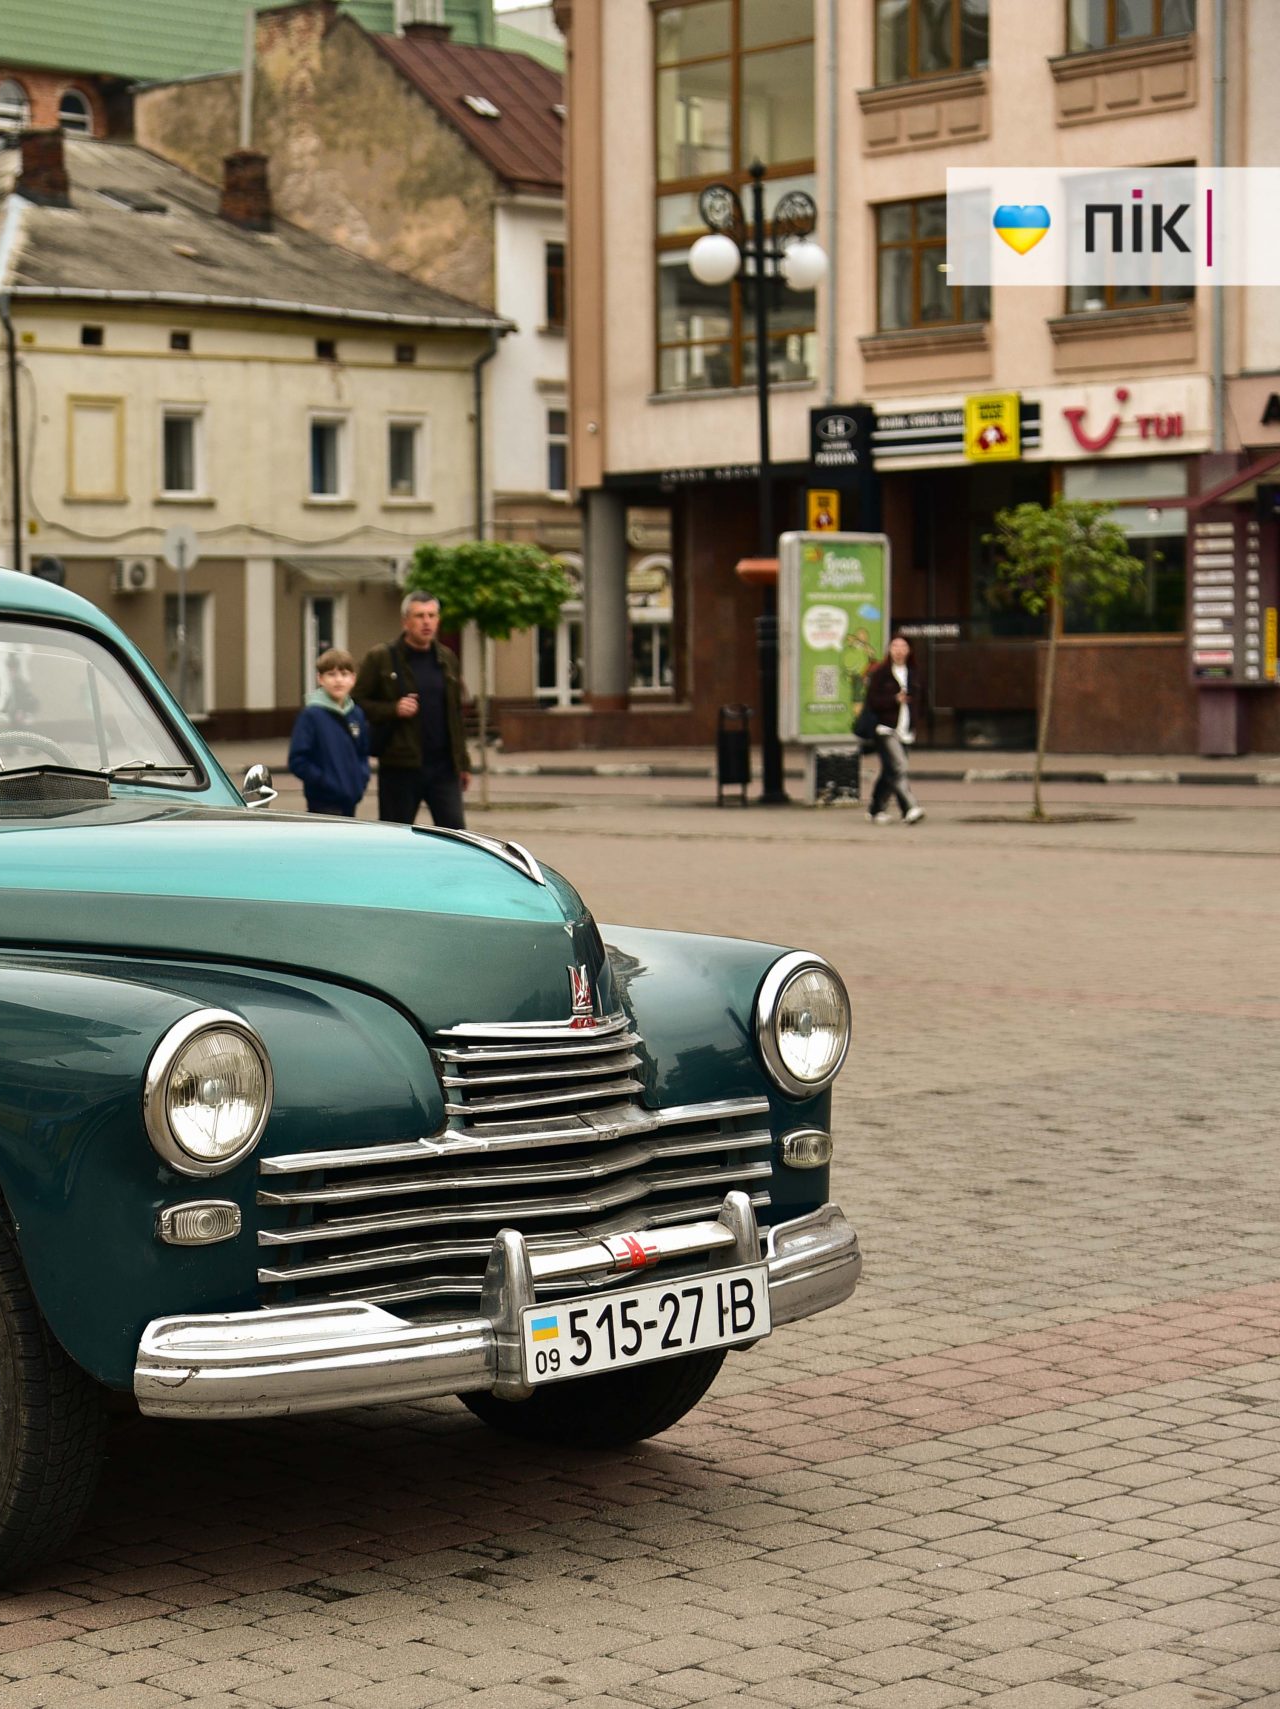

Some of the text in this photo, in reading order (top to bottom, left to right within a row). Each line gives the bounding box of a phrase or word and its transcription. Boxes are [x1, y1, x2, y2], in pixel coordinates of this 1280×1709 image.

[1135, 411, 1184, 440] TUI
[569, 1286, 704, 1367] 515-27
[535, 1348, 561, 1375] 09
